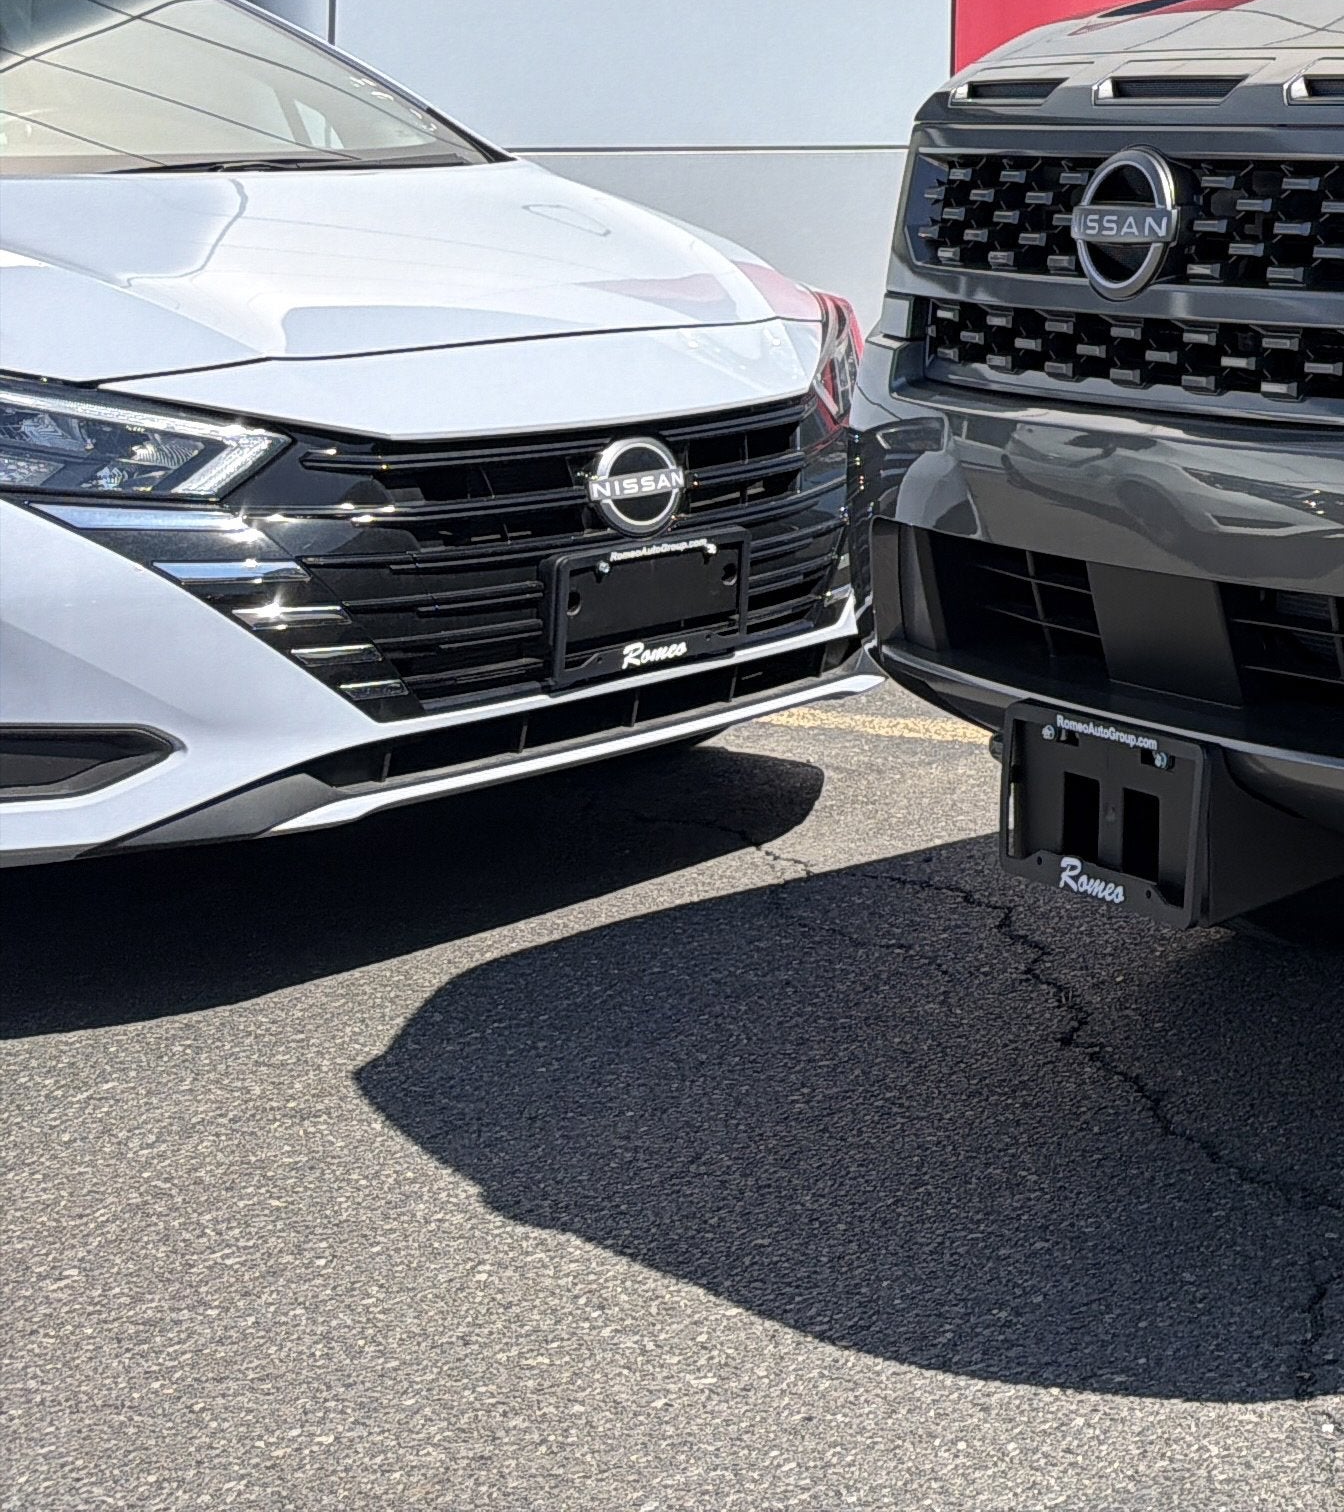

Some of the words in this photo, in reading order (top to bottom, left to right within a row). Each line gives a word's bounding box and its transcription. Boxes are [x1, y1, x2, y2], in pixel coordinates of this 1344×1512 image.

[592, 471, 685, 498] NISSAN
[609, 538, 708, 562] RomeoAutoGroup.com
[621, 641, 688, 670] Romeo
[1056, 713, 1158, 751] RomeoAutoGroup.com
[1058, 855, 1125, 904] Romeo
